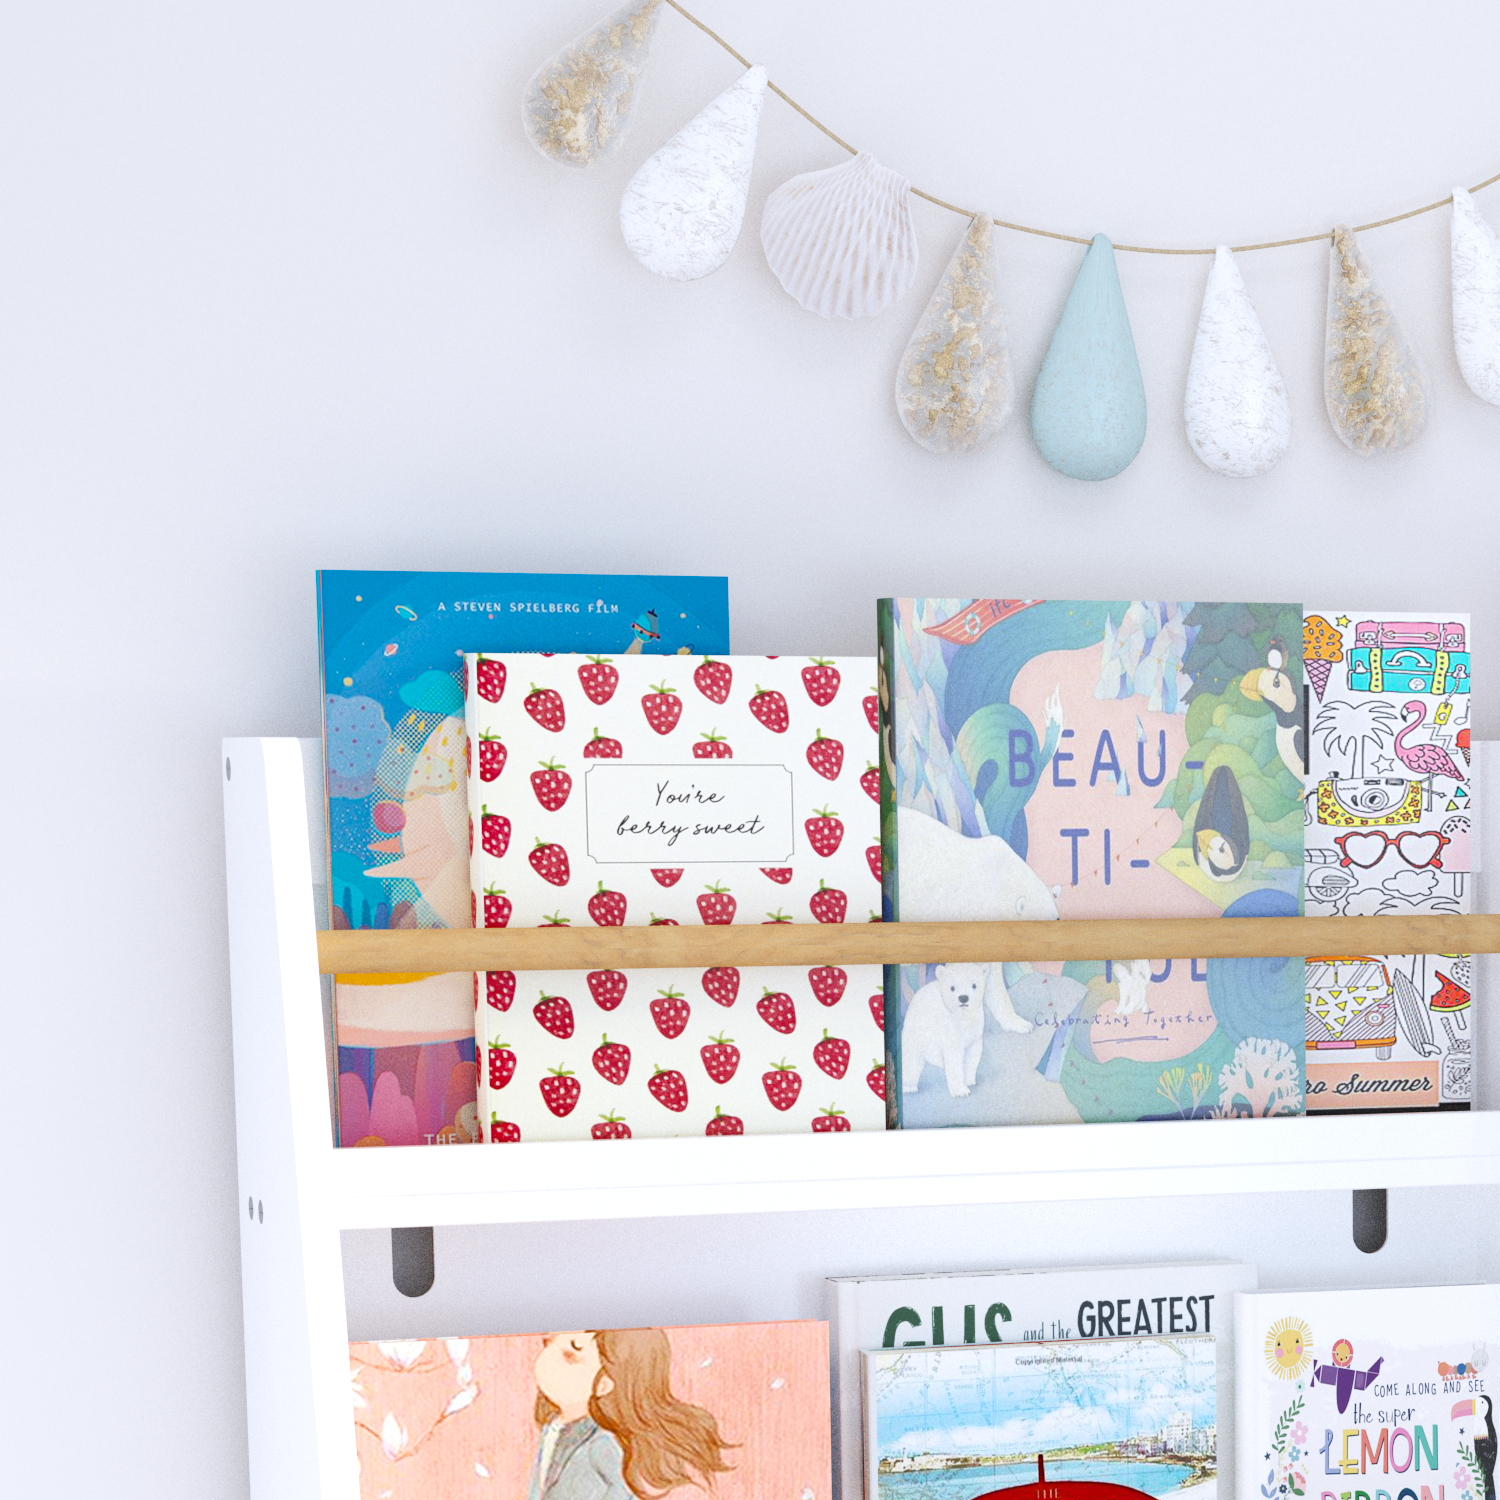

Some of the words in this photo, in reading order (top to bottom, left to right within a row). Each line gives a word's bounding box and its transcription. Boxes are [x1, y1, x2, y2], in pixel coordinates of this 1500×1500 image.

[437, 601, 446, 611] A
[453, 602, 501, 612] STEVEN
[509, 603, 580, 613] SPIELBERG
[588, 604, 619, 613] FILM
[656, 780, 725, 806] You're
[616, 815, 690, 847] berry
[692, 815, 765, 836] sweet
[1060, 828, 1150, 886] TI-
[1034, 1012, 1129, 1027] Celebrating
[1143, 1011, 1213, 1029] Together
[1332, 1073, 1434, 1096] Summer
[1023, 1321, 1045, 1341] and
[1050, 1319, 1072, 1339] the
[1077, 1295, 1214, 1338] GREATEST
[1374, 1384, 1399, 1397] COME
[1405, 1383, 1437, 1396] ALONG
[1444, 1381, 1462, 1394] AND
[1468, 1380, 1485, 1393] SEE
[1353, 1402, 1373, 1425] the
[1378, 1408, 1415, 1427] super
[1319, 1424, 1439, 1475] LEMON
